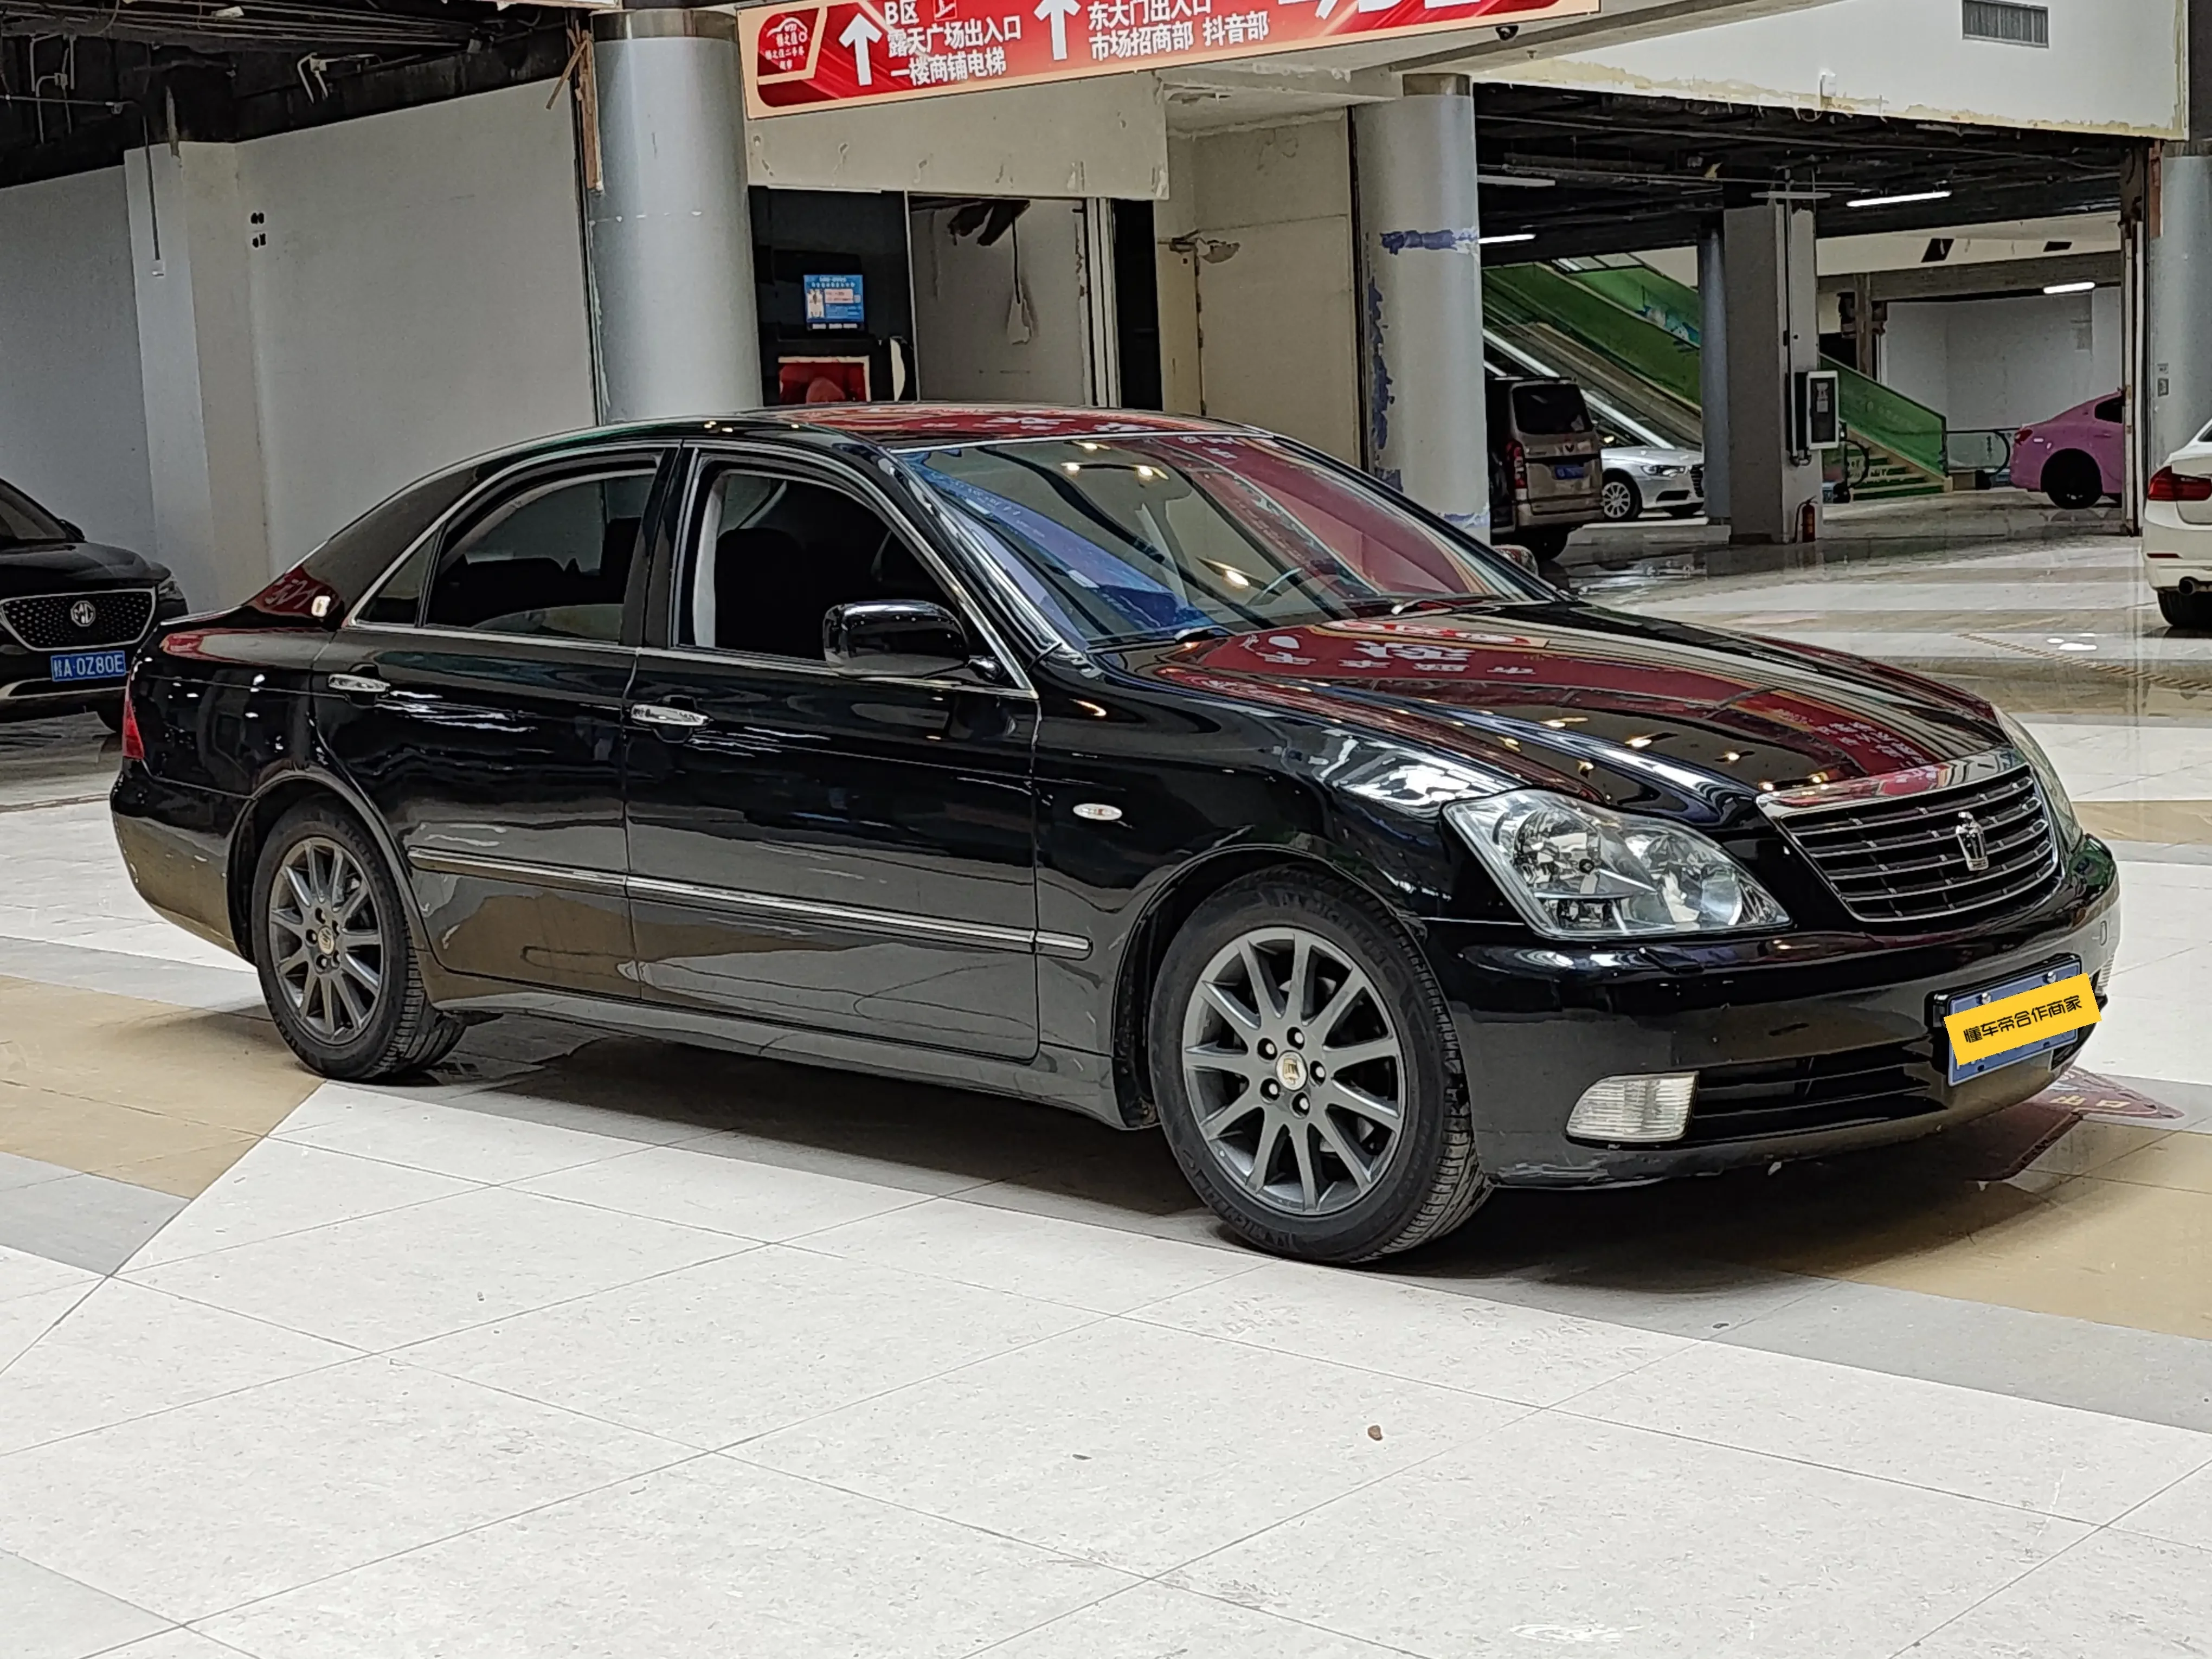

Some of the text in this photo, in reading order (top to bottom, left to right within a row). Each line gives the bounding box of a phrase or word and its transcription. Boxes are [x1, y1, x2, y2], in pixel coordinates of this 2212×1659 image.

[884, 0, 919, 25] B区
[1088, 0, 1211, 30] 东大门出入口
[888, 15, 1021, 57] 露天广场出入口
[1089, 11, 1269, 61] 市场招商部 抖音部
[890, 46, 1006, 86] 一楼商铺电梯
